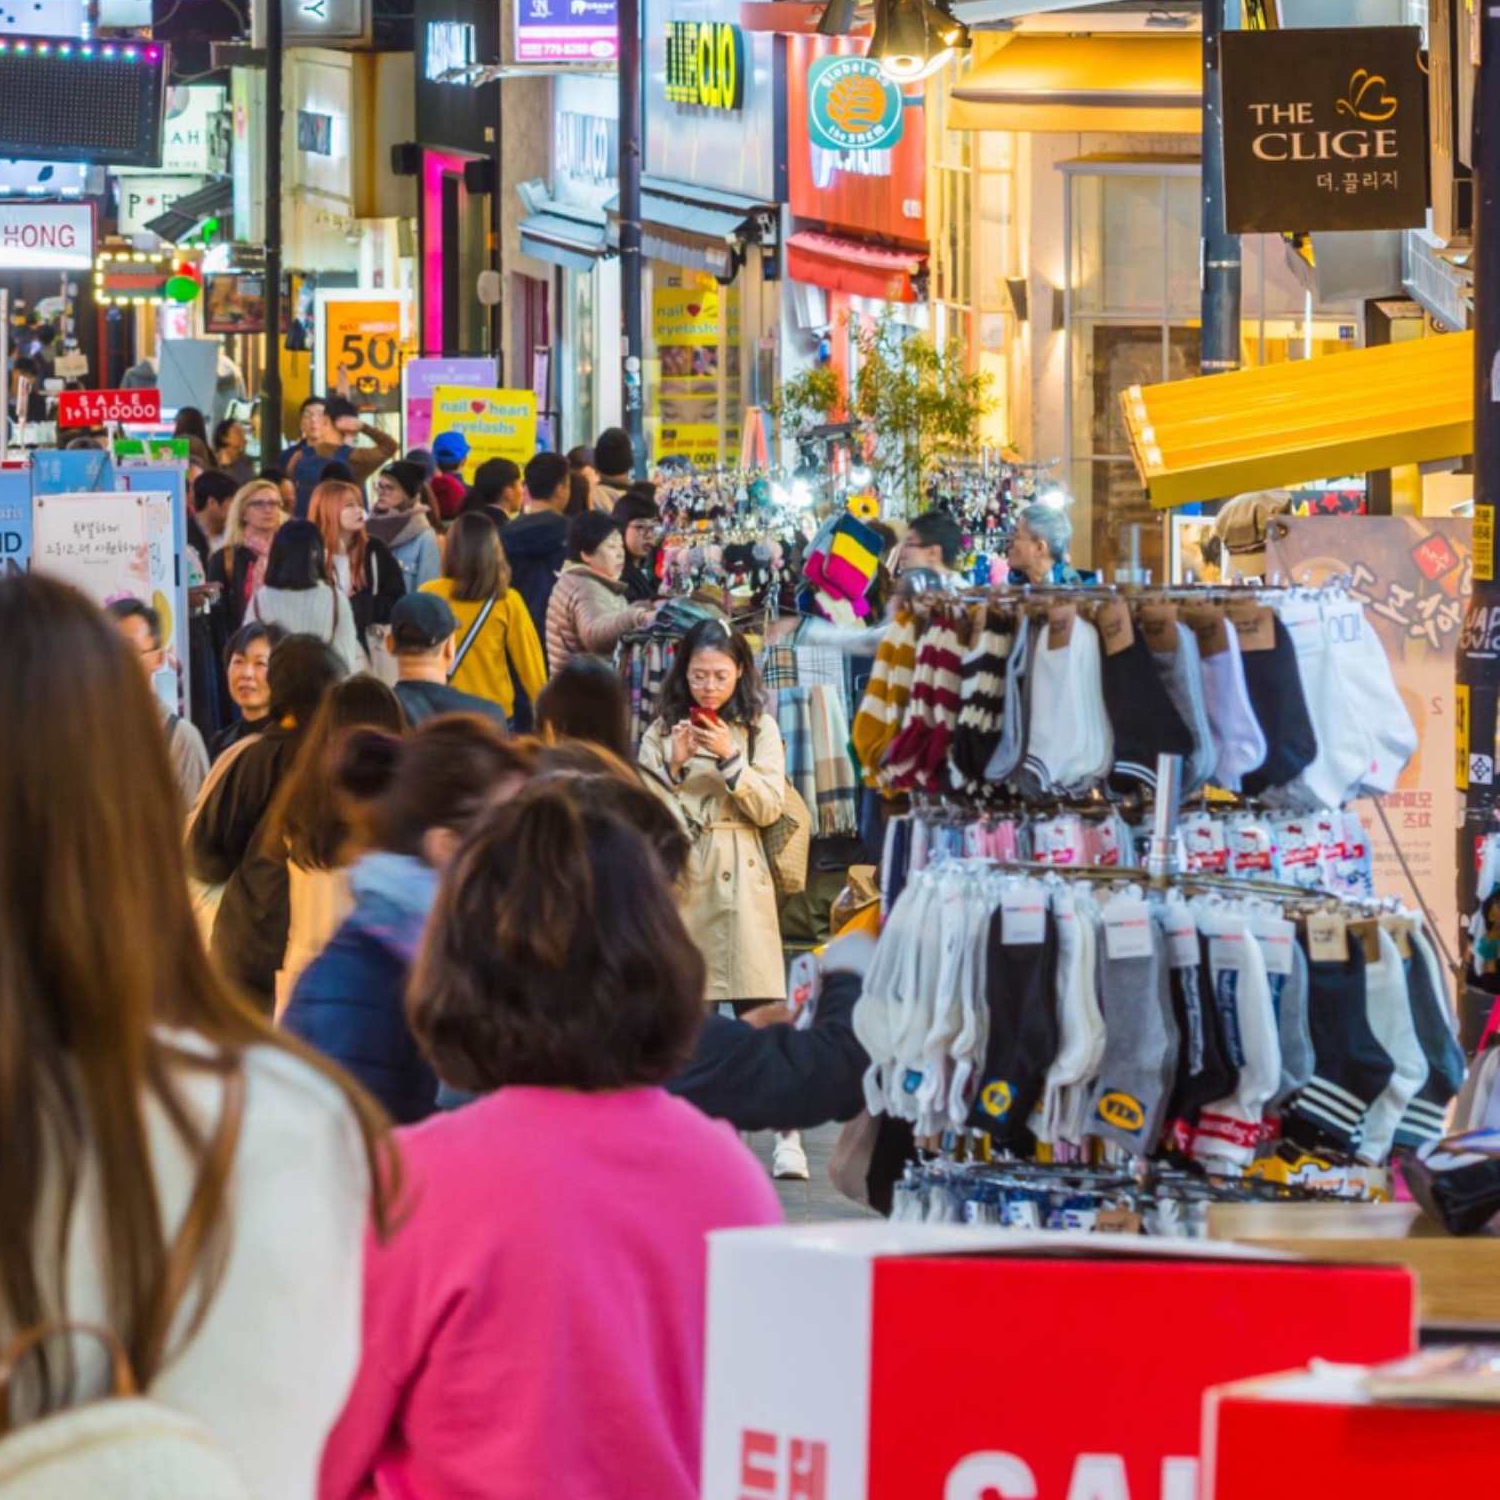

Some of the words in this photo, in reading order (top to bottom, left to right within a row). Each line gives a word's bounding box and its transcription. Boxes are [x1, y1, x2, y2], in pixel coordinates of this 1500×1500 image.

[1248, 102, 1315, 125] THE
[1251, 128, 1398, 162] CLIGE
[3, 223, 77, 249] HONG
[79, 393, 141, 407] SALE
[488, 402, 529, 417] heart
